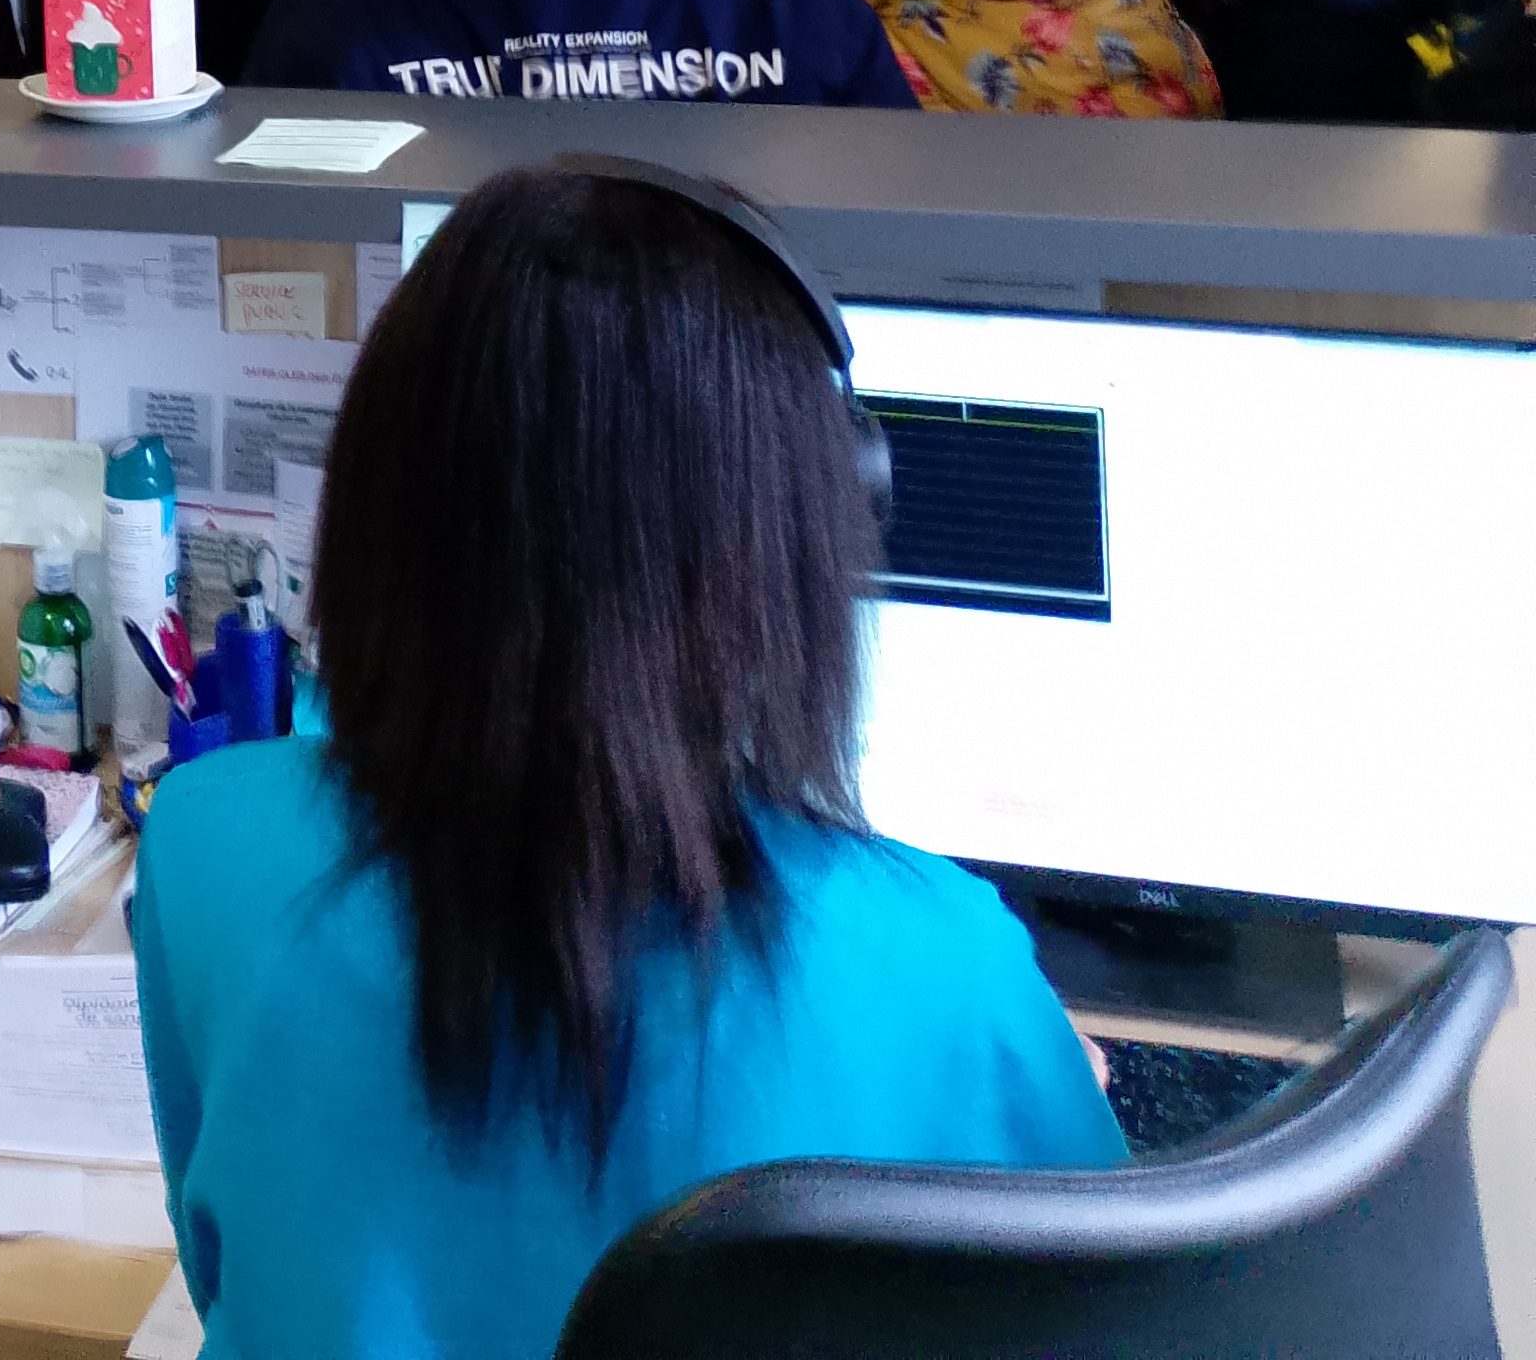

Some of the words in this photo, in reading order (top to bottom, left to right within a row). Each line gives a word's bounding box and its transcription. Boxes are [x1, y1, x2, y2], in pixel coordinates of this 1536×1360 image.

[505, 32, 560, 54] REALITY
[565, 30, 649, 48] EXPANSION
[521, 47, 785, 99] DIMENSION
